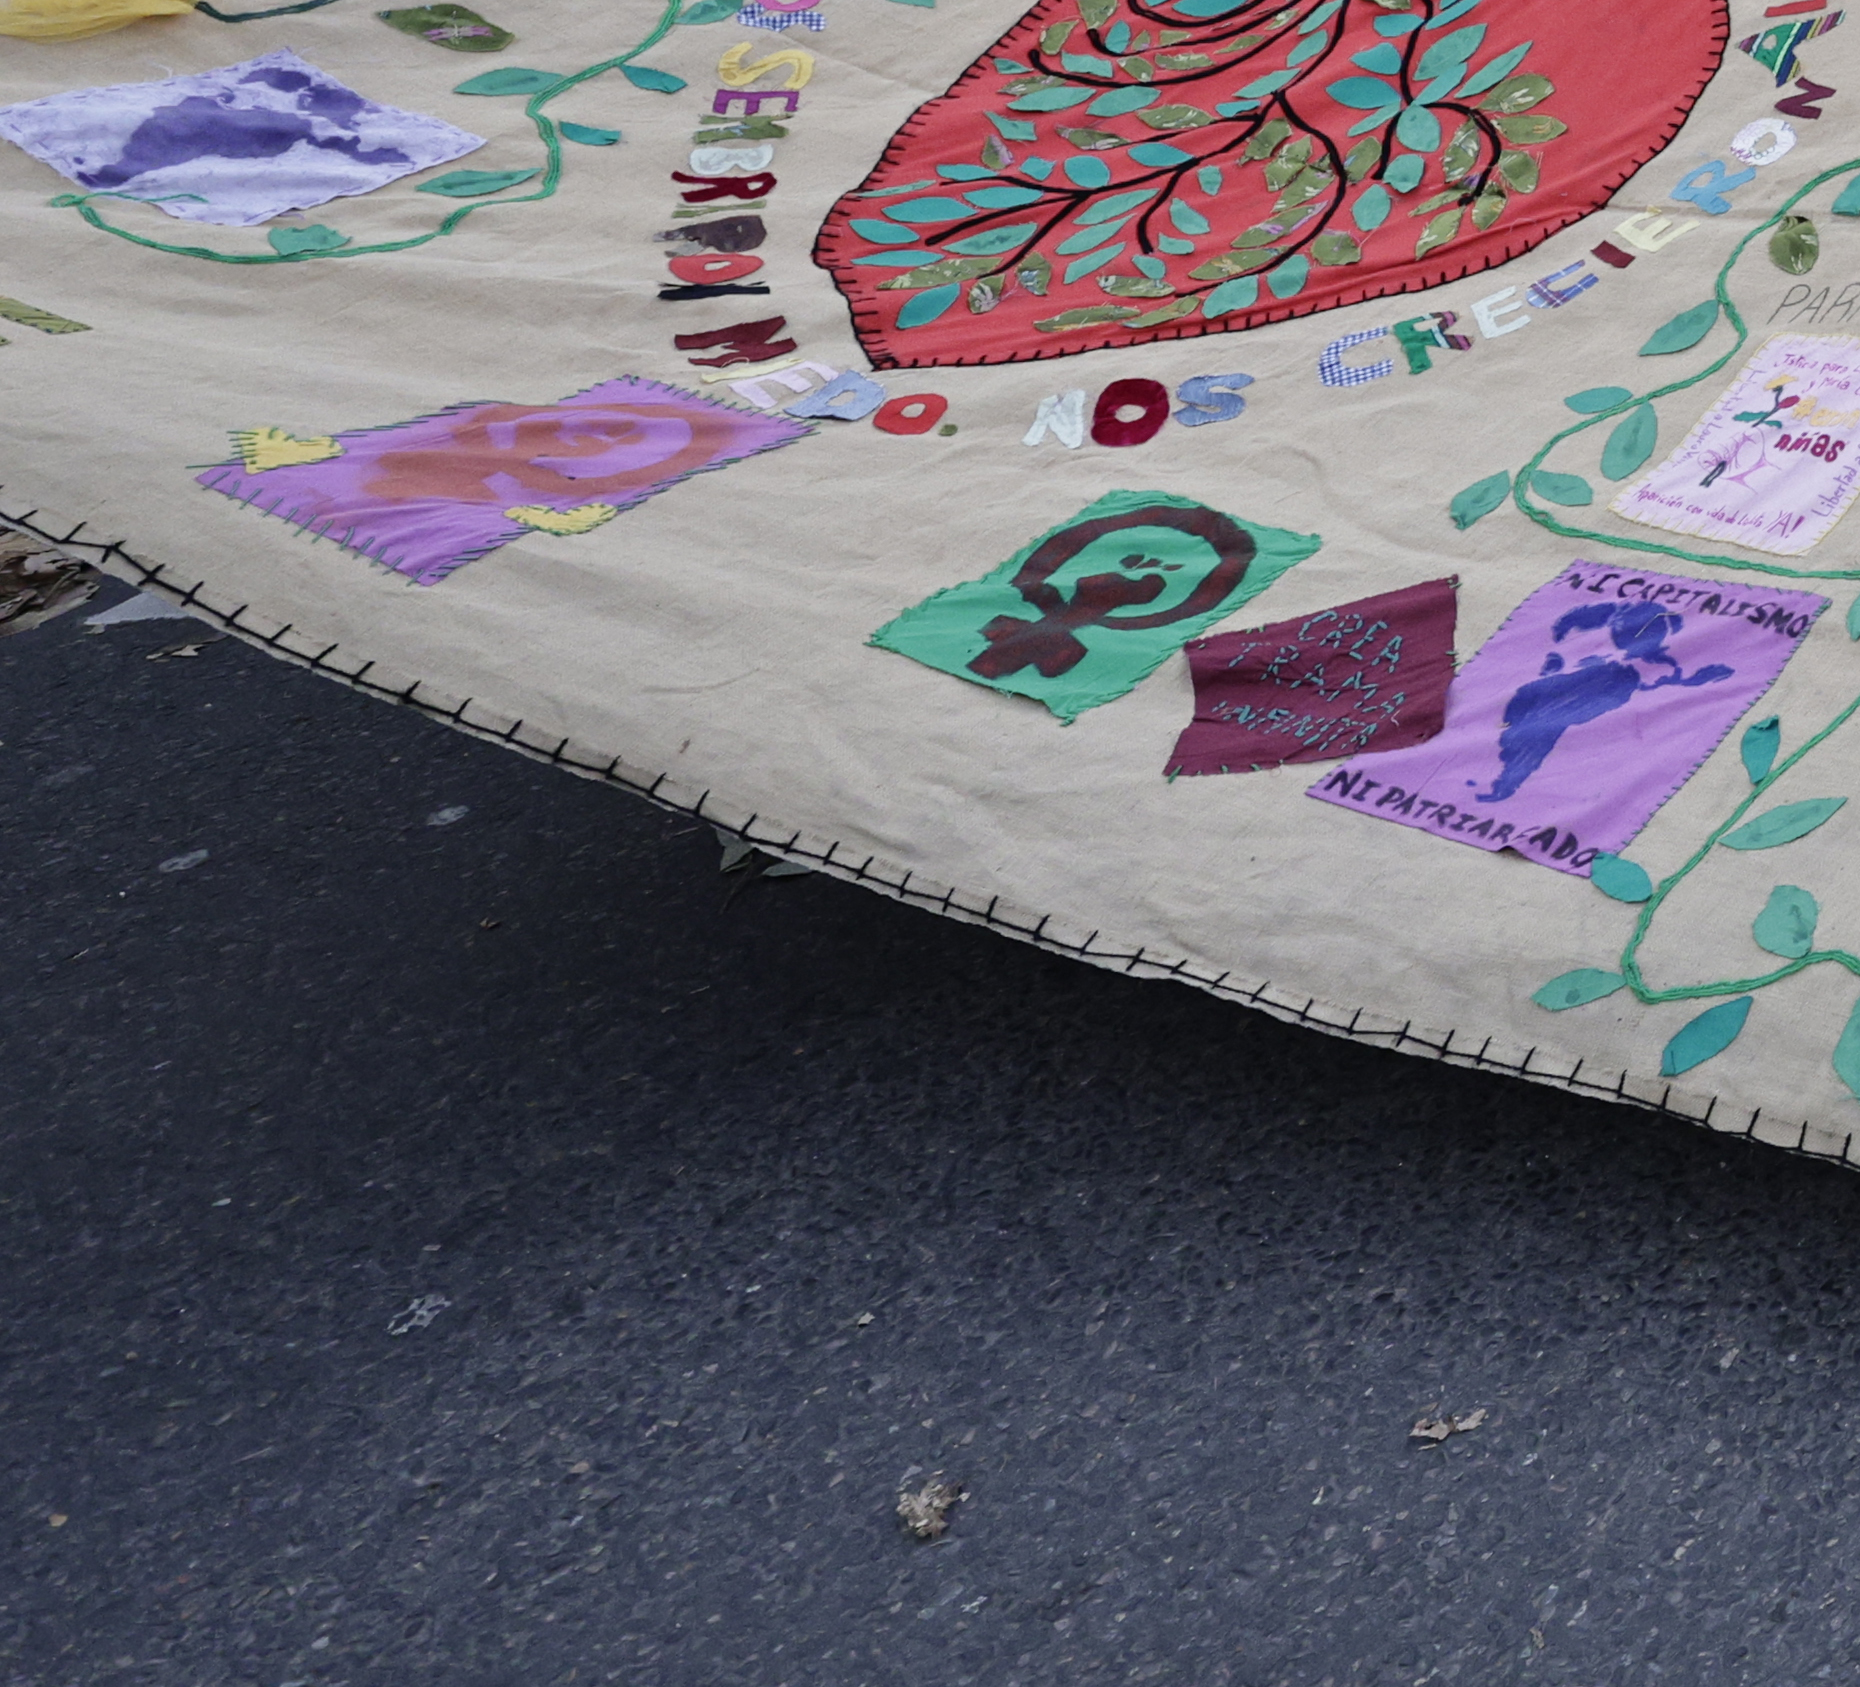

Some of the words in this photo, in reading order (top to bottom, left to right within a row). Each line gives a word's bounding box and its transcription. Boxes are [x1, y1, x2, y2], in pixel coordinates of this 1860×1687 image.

[1022, 372, 1254, 449] NOS
[1811, 466, 1858, 517] Libertad
[1563, 558, 1612, 600] NI
[1616, 573, 1810, 640] CAPITALISMO
[1298, 610, 1403, 674] CREA
[1228, 641, 1405, 720] TRAMA
[1327, 769, 1375, 808] NI
